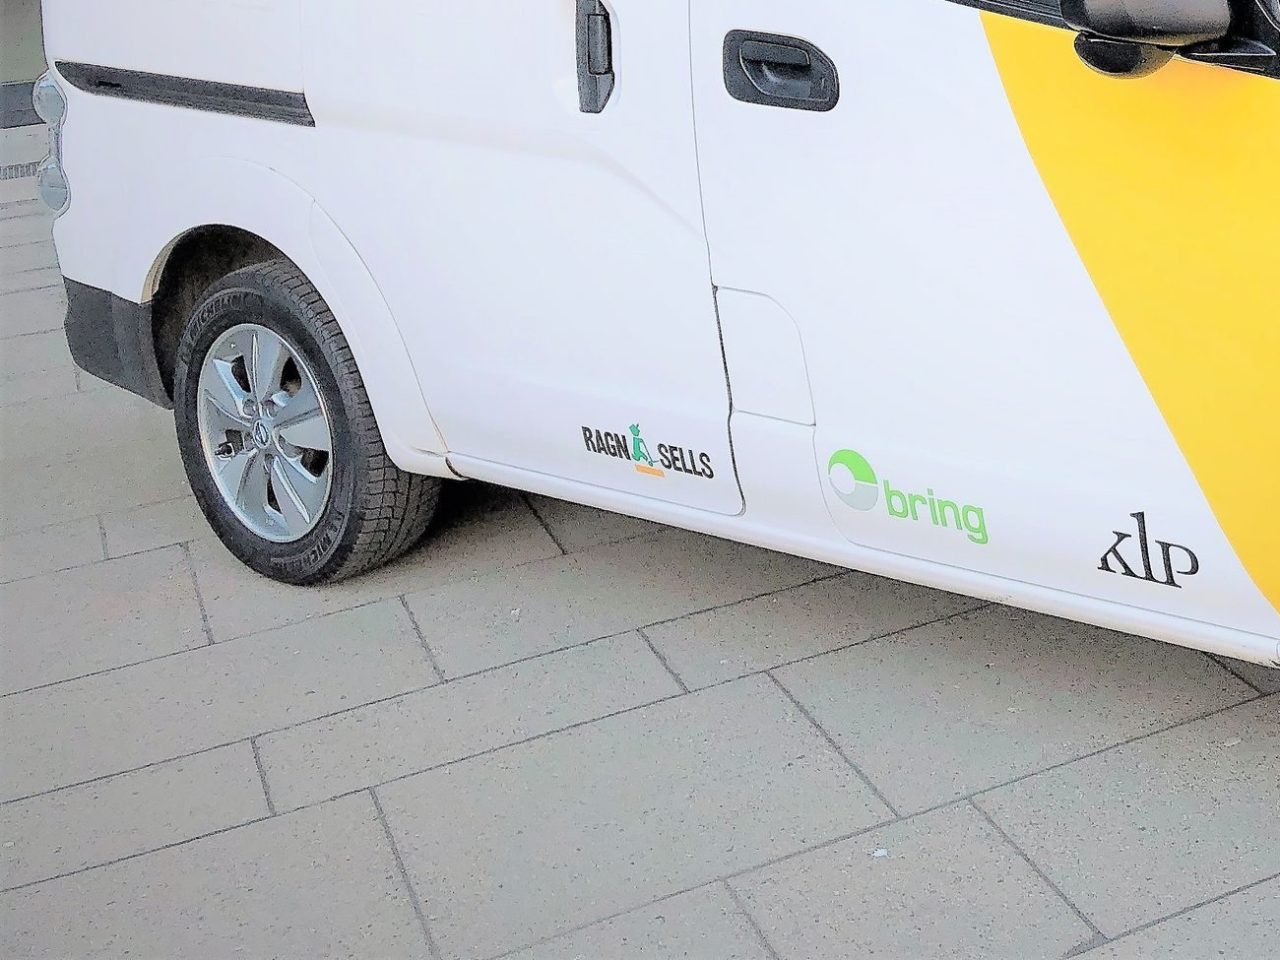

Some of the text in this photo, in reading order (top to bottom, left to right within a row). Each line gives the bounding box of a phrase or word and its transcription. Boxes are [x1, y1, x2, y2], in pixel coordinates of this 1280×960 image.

[581, 426, 714, 479] RAGN SELLS
[883, 479, 989, 545] bring
